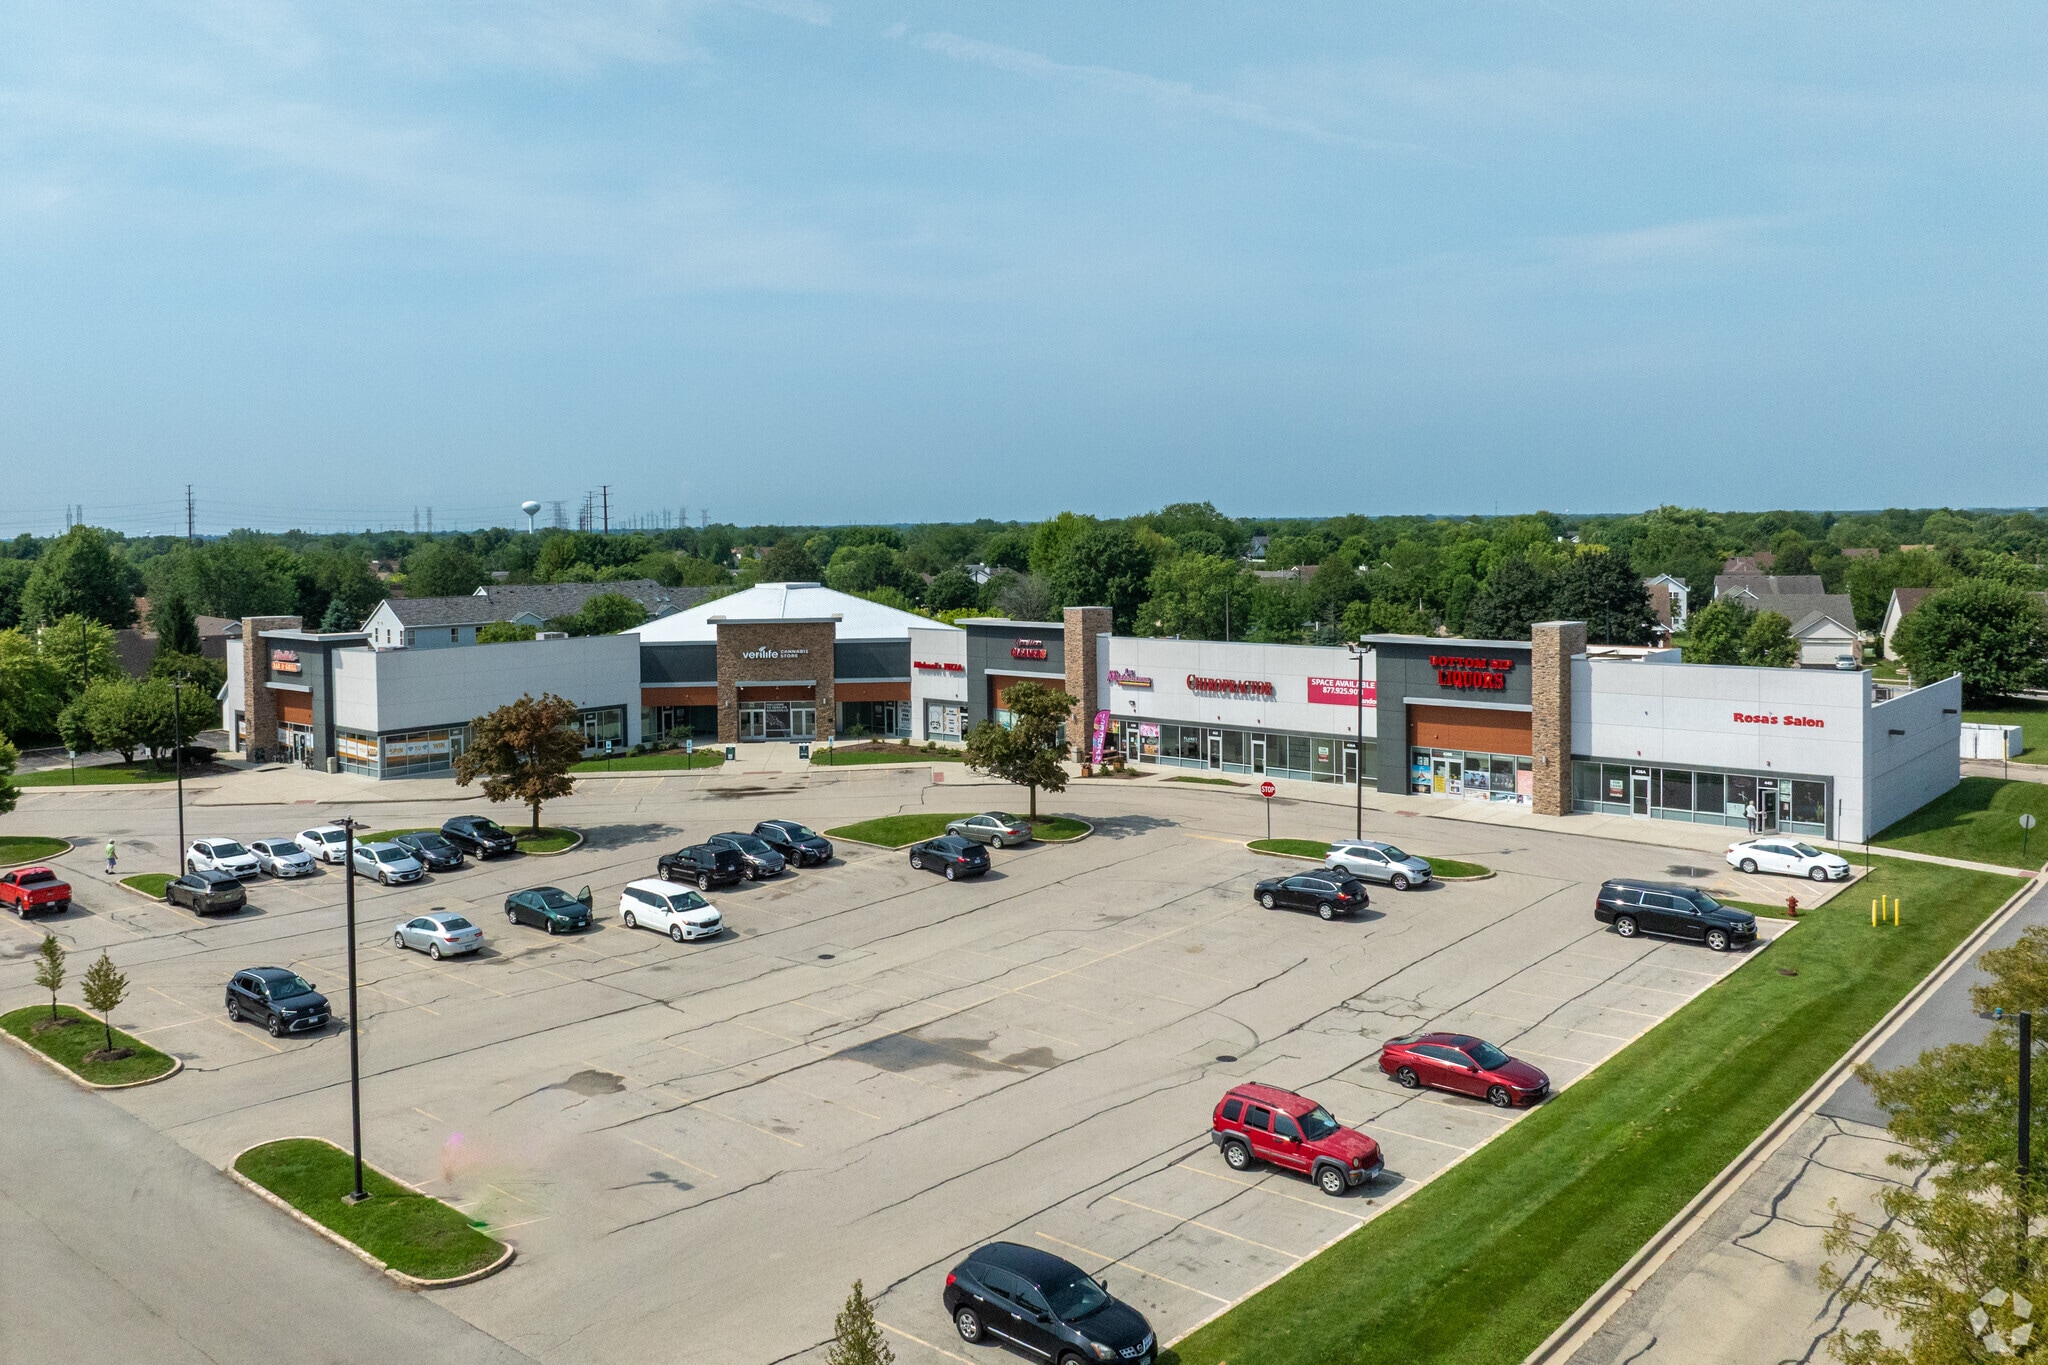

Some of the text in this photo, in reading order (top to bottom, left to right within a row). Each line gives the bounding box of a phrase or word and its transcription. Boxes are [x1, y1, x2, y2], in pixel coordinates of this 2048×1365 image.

[742, 647, 779, 659] verilife
[1010, 647, 1047, 659] CLEANERS
[943, 663, 963, 672] PIZZA
[1429, 655, 1487, 669] BOTTOM
[1311, 679, 1376, 689] SPACE AVAILABLE
[1437, 669, 1505, 689] LIQUORS
[1733, 712, 1825, 728] Rosa's Salon
[389, 747, 404, 755] SPIN
[433, 742, 446, 750] WIN
[1261, 785, 1275, 793] STOP
